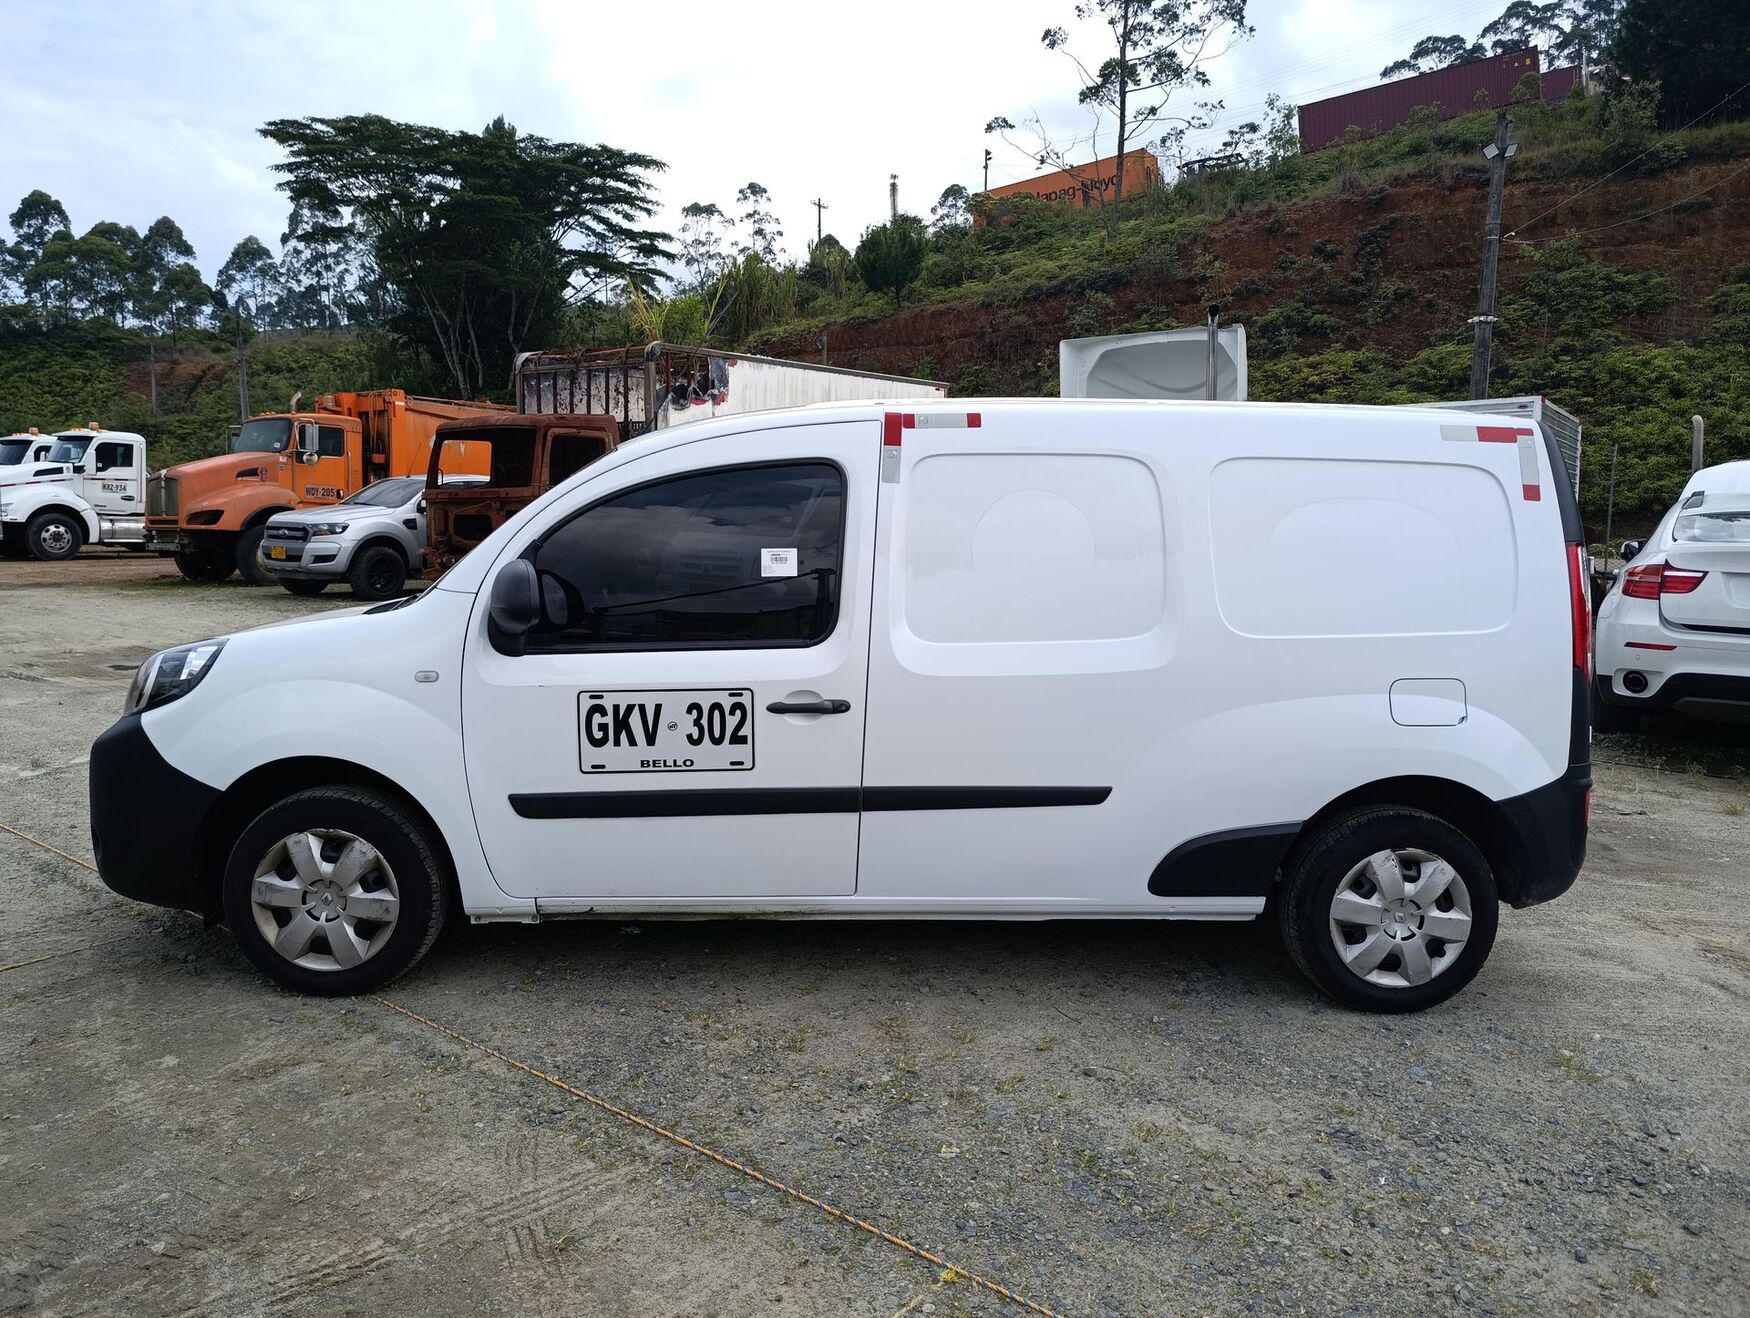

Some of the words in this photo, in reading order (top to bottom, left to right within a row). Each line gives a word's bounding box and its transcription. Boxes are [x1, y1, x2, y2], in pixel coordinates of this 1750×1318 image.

[584, 703, 663, 748] GKV
[685, 701, 748, 746] 302
[640, 758, 695, 768] BELLO
